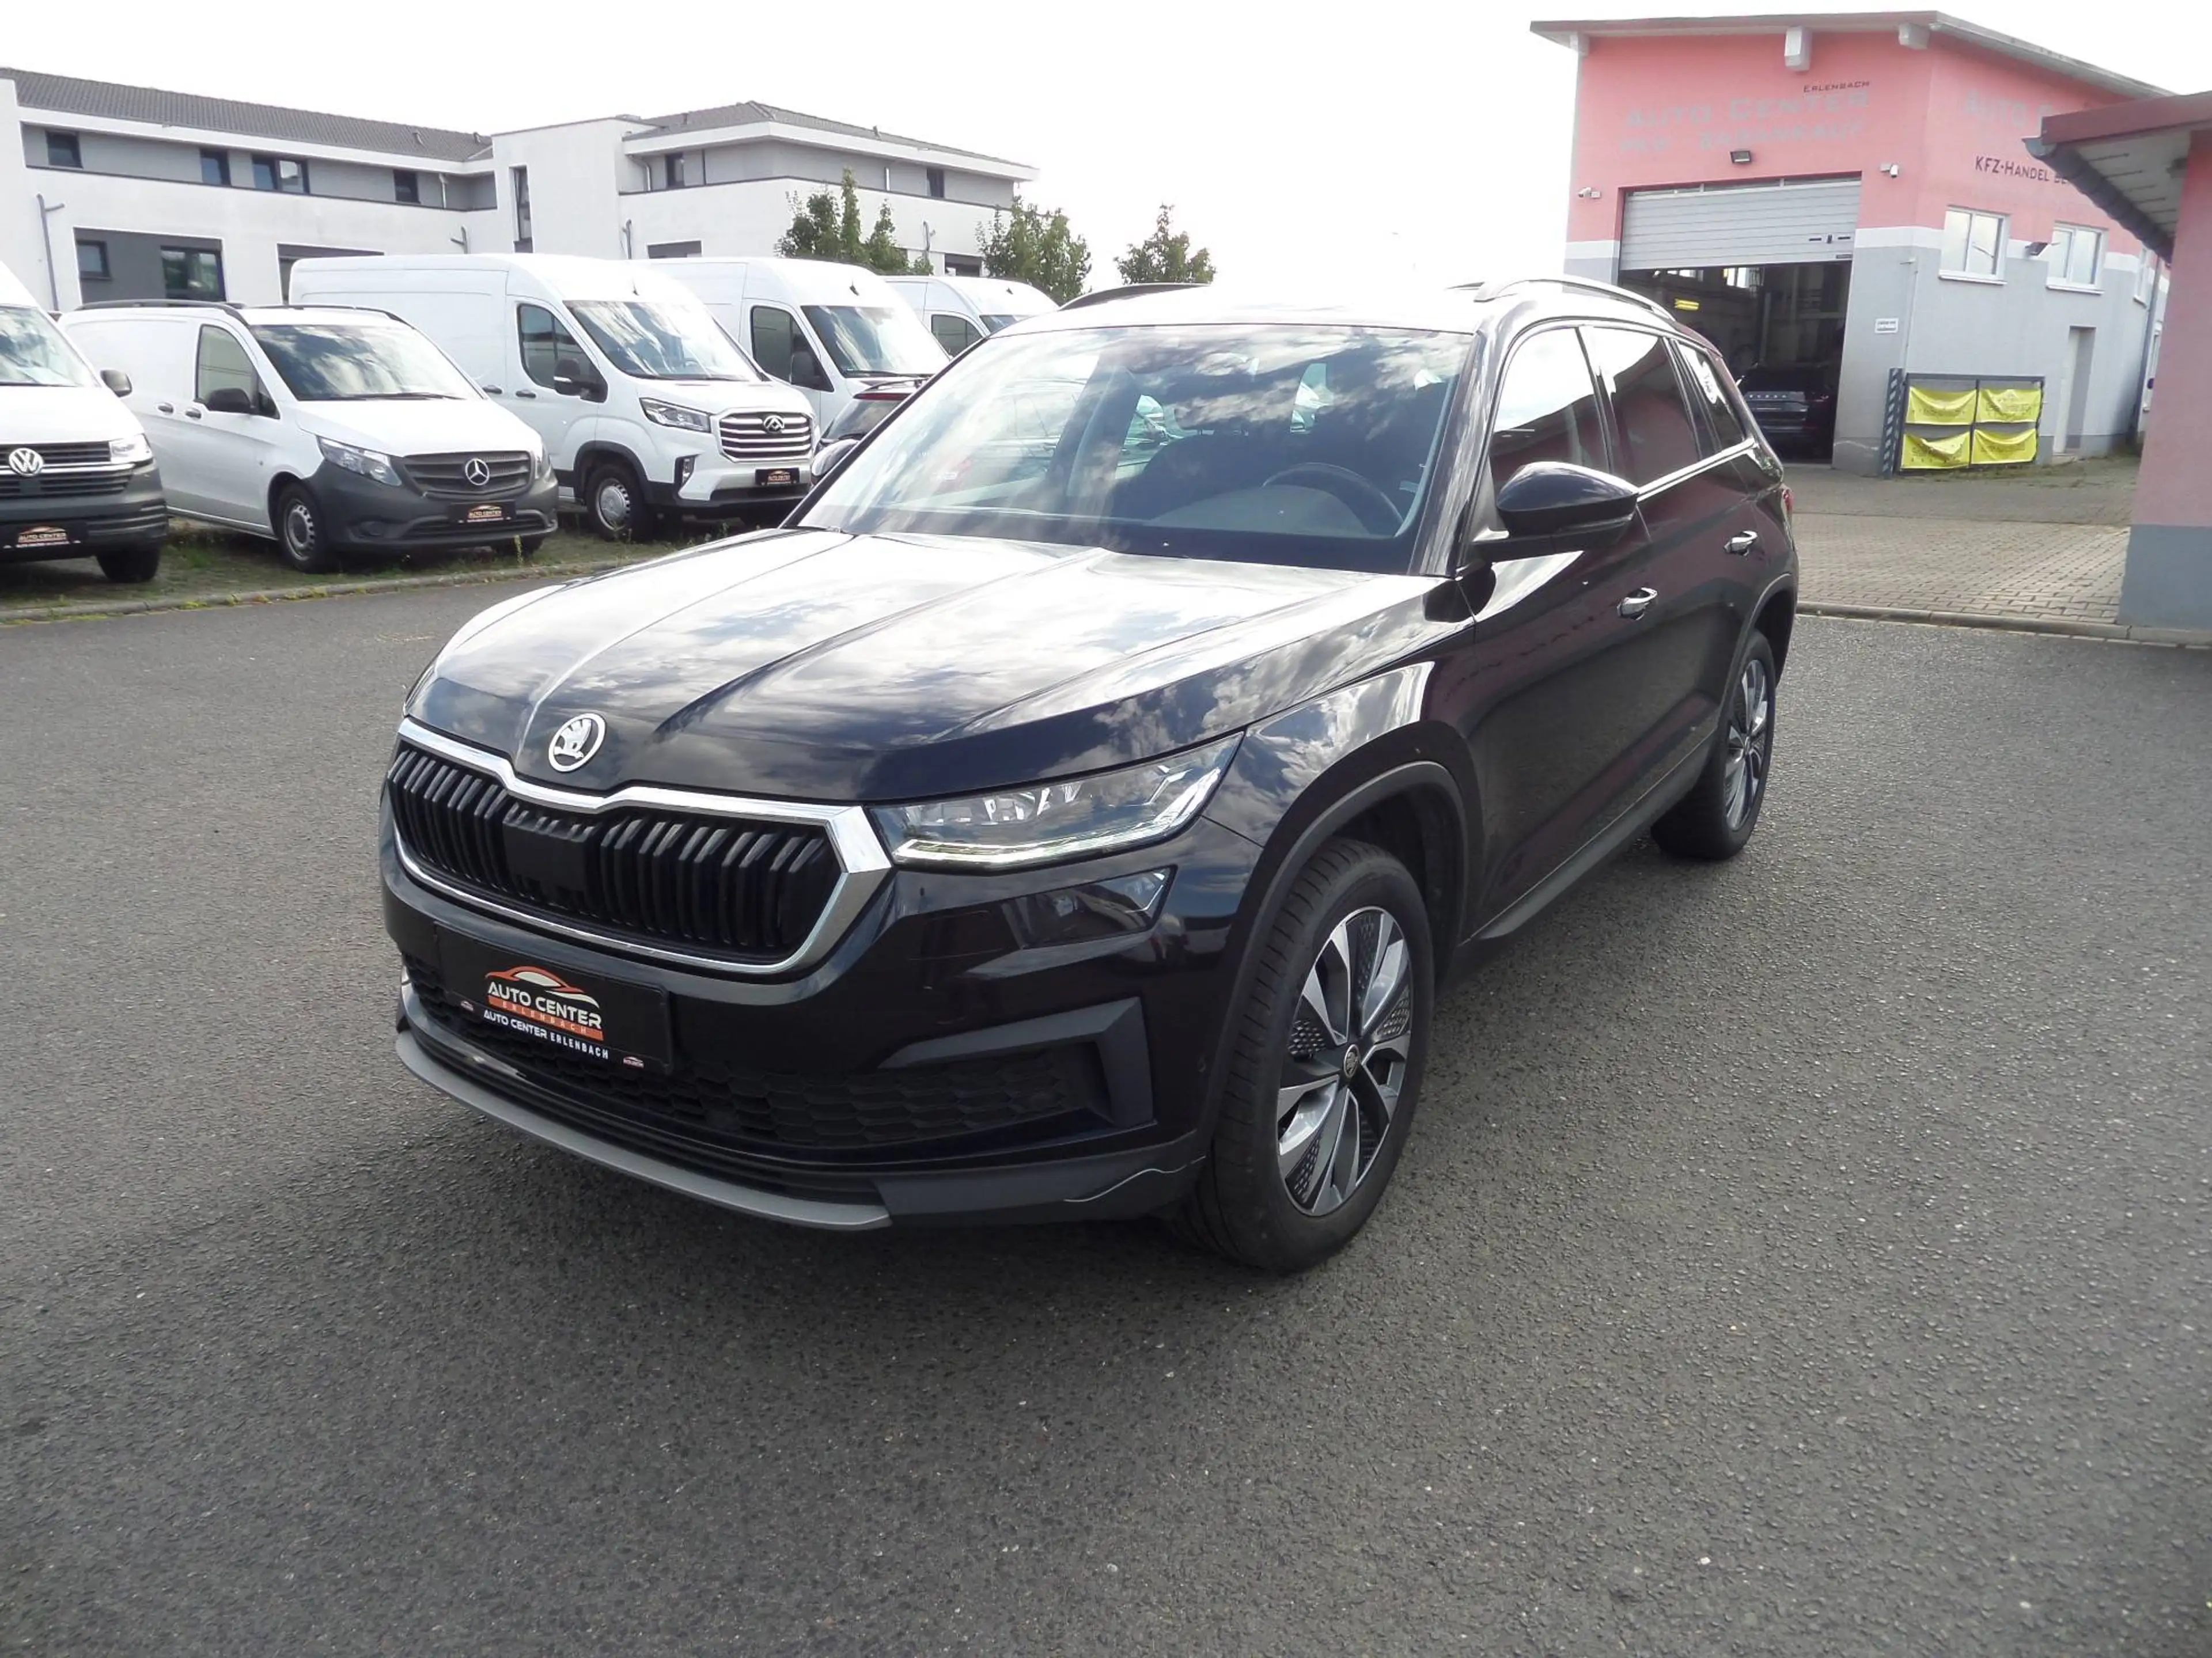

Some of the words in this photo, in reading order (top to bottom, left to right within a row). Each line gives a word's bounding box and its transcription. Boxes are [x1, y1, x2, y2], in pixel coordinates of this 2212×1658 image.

[488, 981, 532, 1007] AUTO
[535, 996, 602, 1030] CENTER
[502, 1000, 588, 1035] ERLENBACH
[484, 1009, 509, 1026] AUTO
[510, 1019, 548, 1038] CENTER
[550, 1031, 609, 1060] ERLENBACH
